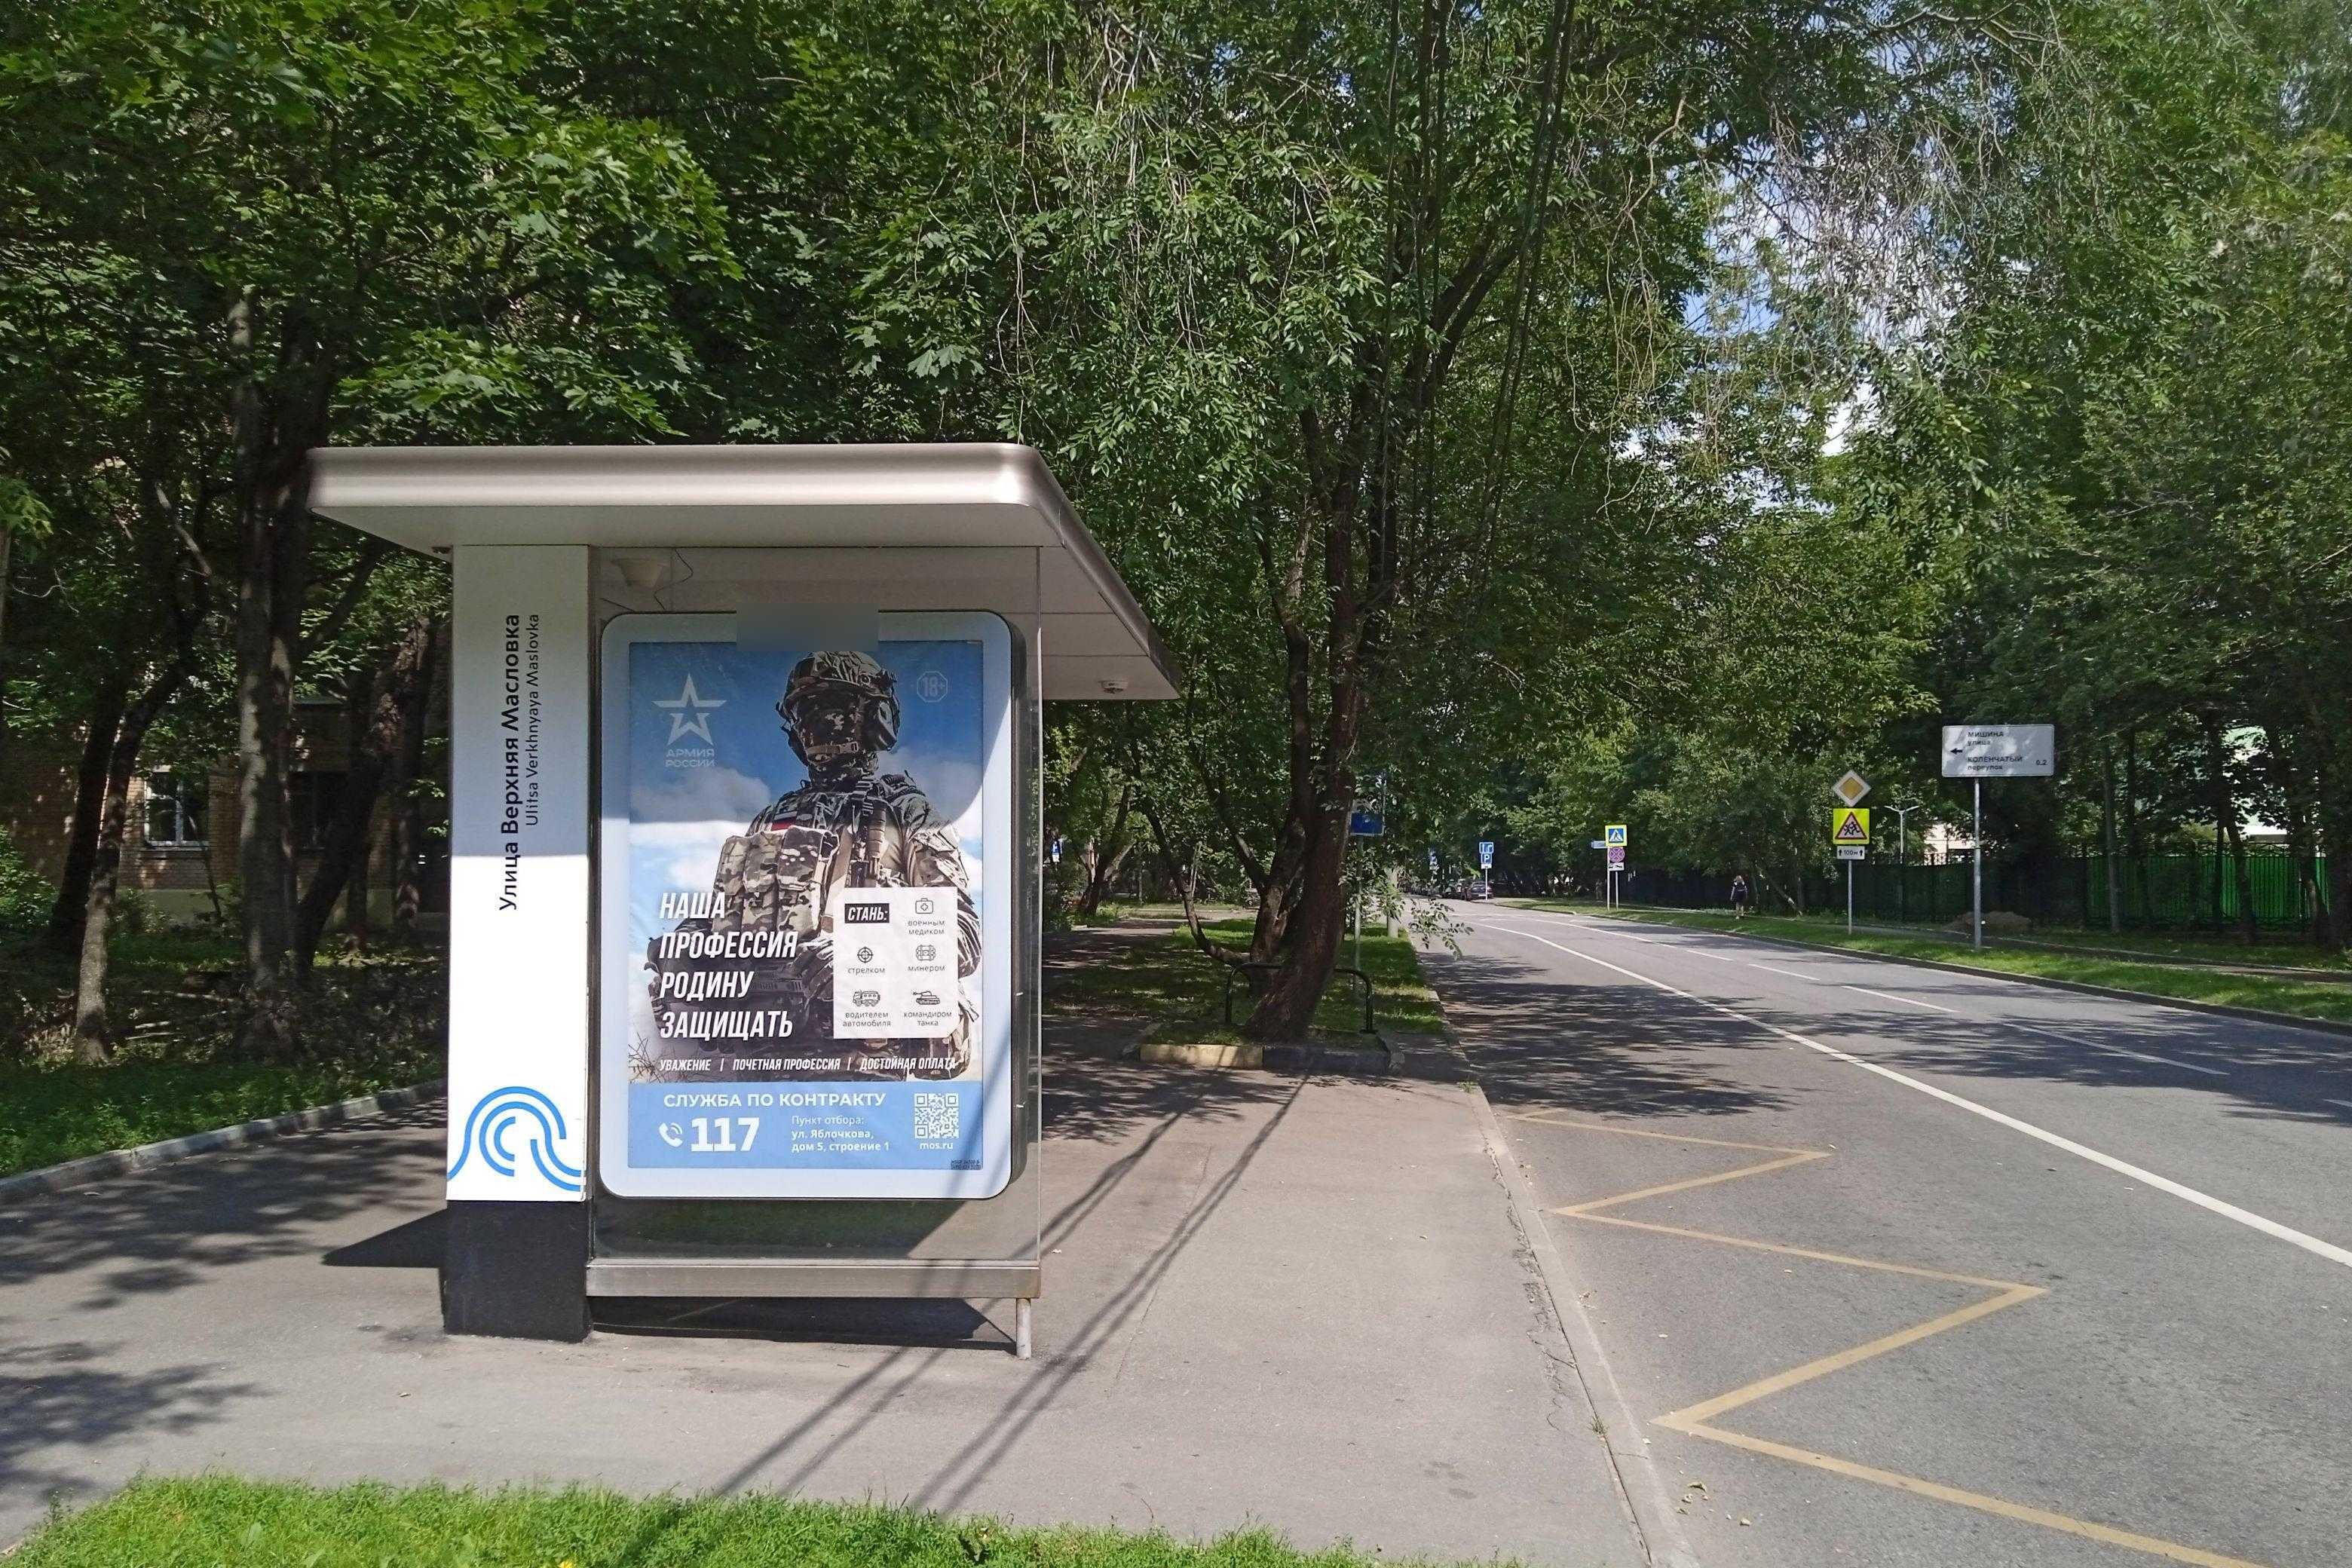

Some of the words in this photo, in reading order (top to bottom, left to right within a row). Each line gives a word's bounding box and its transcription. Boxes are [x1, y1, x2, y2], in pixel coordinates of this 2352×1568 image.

[525, 614, 539, 687] Maslovka
[501, 614, 519, 731] Масловка
[922, 676, 945, 697] 18+
[525, 691, 541, 778] Verkhnyaya
[665, 759, 715, 767] РОССИИ
[666, 749, 715, 758] АРМИЯ
[501, 738, 523, 834] Верхняя
[525, 782, 538, 825] Ulitsa
[499, 842, 521, 911] Улица
[659, 892, 725, 919] НАША
[847, 907, 888, 921] СТАНЬ:
[659, 931, 798, 959] ПРОФЕССИЯ
[660, 971, 755, 1002] РОДИНУ
[660, 1011, 793, 1042] ЗАЩИЩАТЬ
[660, 1058, 712, 1071] УВАЖЕНИЕ
[733, 1058, 782, 1070] ПОЧЕТНАЯ
[783, 1058, 841, 1070] ПРОФЕССИЯ
[859, 1055, 916, 1070] ДОСТОЙНАЯ
[918, 1057, 957, 1070] ОПЛАТА
[663, 1094, 742, 1107] СЛУЖБА
[747, 1094, 773, 1107] ПО
[779, 1093, 887, 1107] КОНТРАКТУ
[792, 1116, 822, 1126] Пункт
[825, 1115, 865, 1126] отбора:
[691, 1117, 760, 1152] 117
[792, 1131, 808, 1139] ул.
[810, 1129, 874, 1140] Яблочкова,
[792, 1143, 814, 1153] дом
[816, 1142, 826, 1152] 5,
[829, 1143, 881, 1153] строение
[884, 1142, 890, 1151] 1
[919, 1142, 954, 1150] mos.ru
